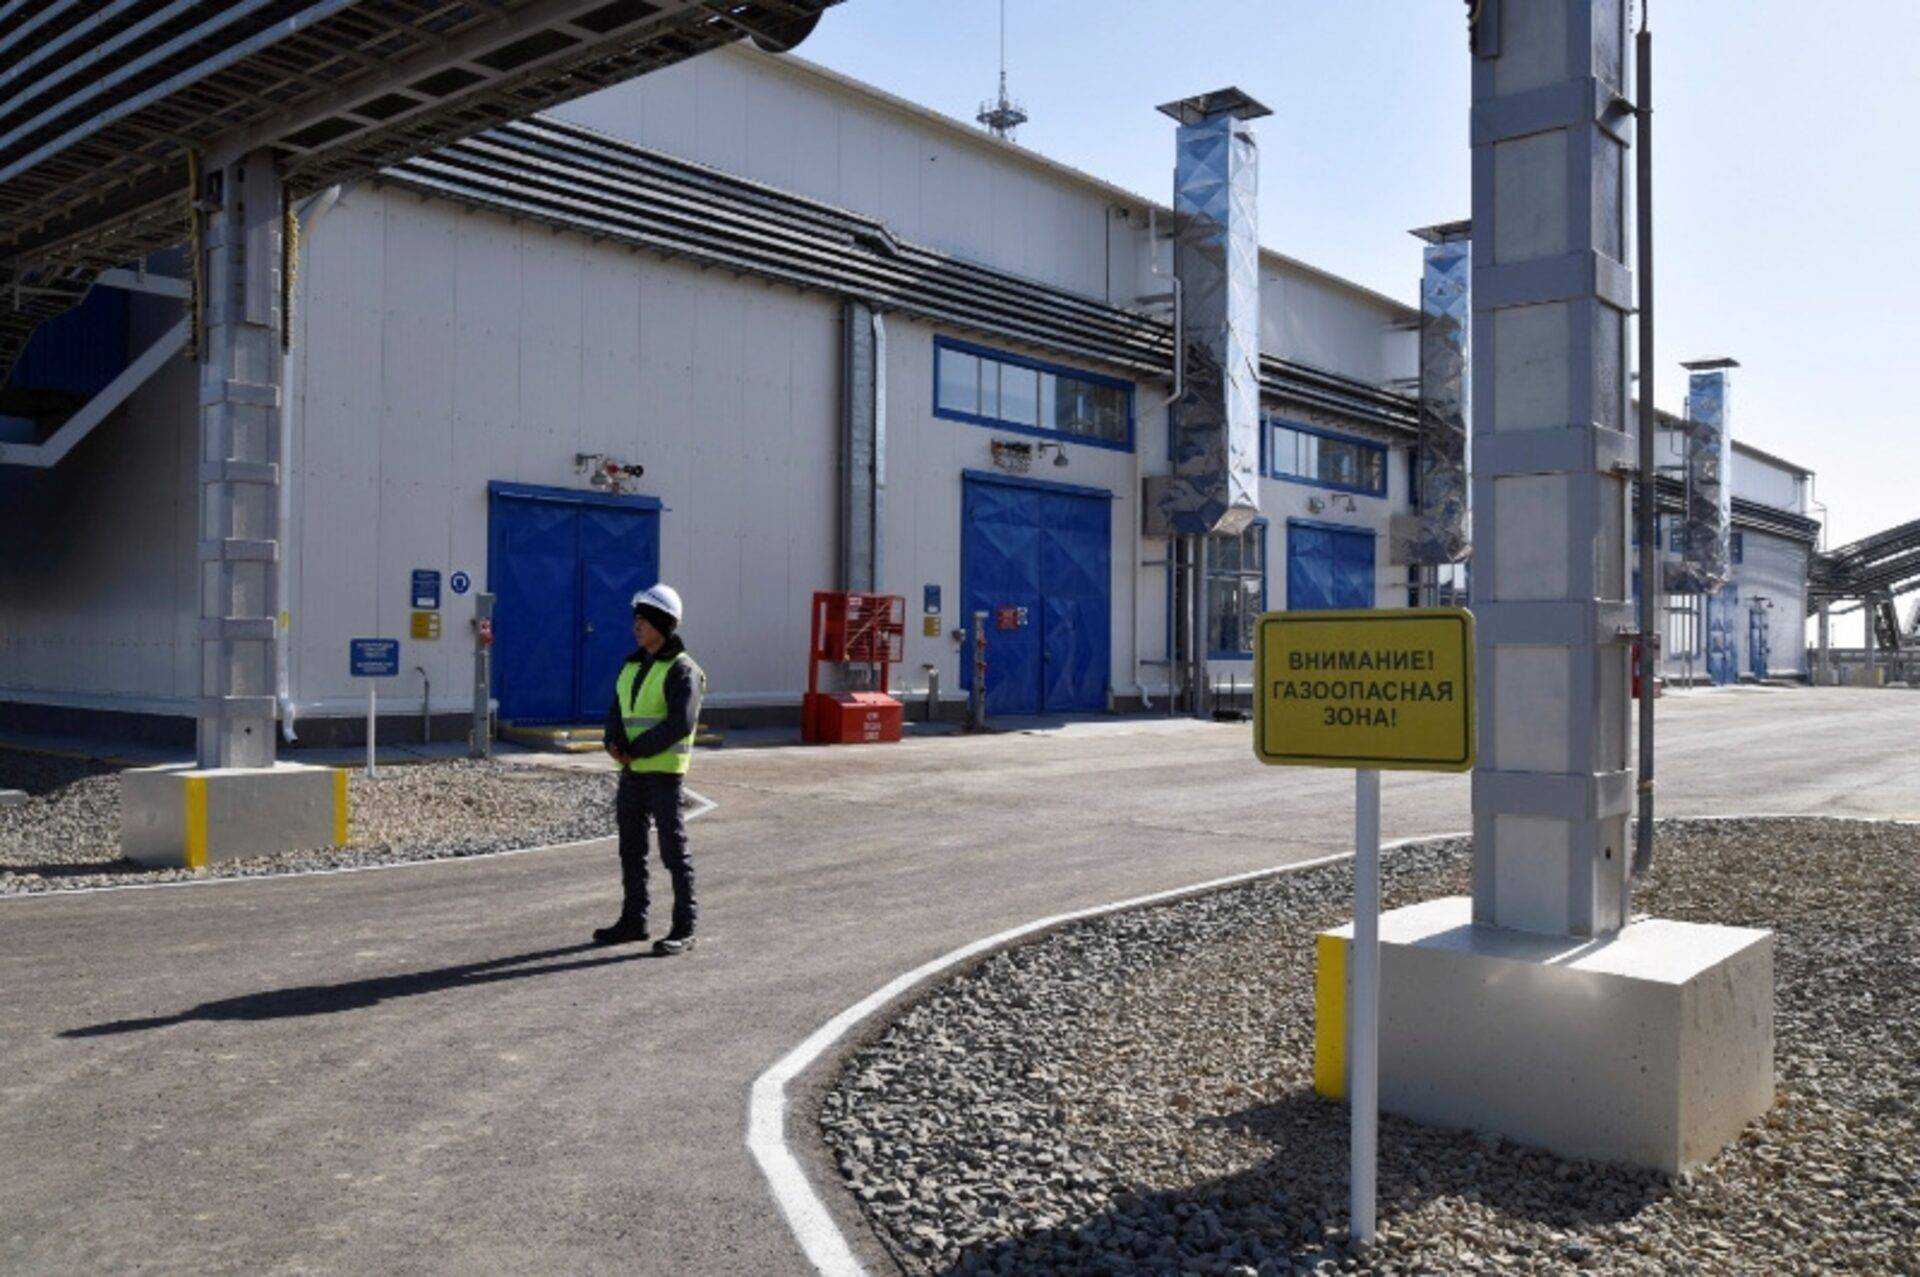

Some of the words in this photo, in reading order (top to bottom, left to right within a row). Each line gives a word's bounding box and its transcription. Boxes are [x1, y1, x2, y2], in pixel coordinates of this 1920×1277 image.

[1288, 650, 1434, 671] ВНИМАНИЕ!
[1273, 681, 1454, 701] ГАЗООПАСНАЯ
[1324, 707, 1397, 727] ЗОНА!
